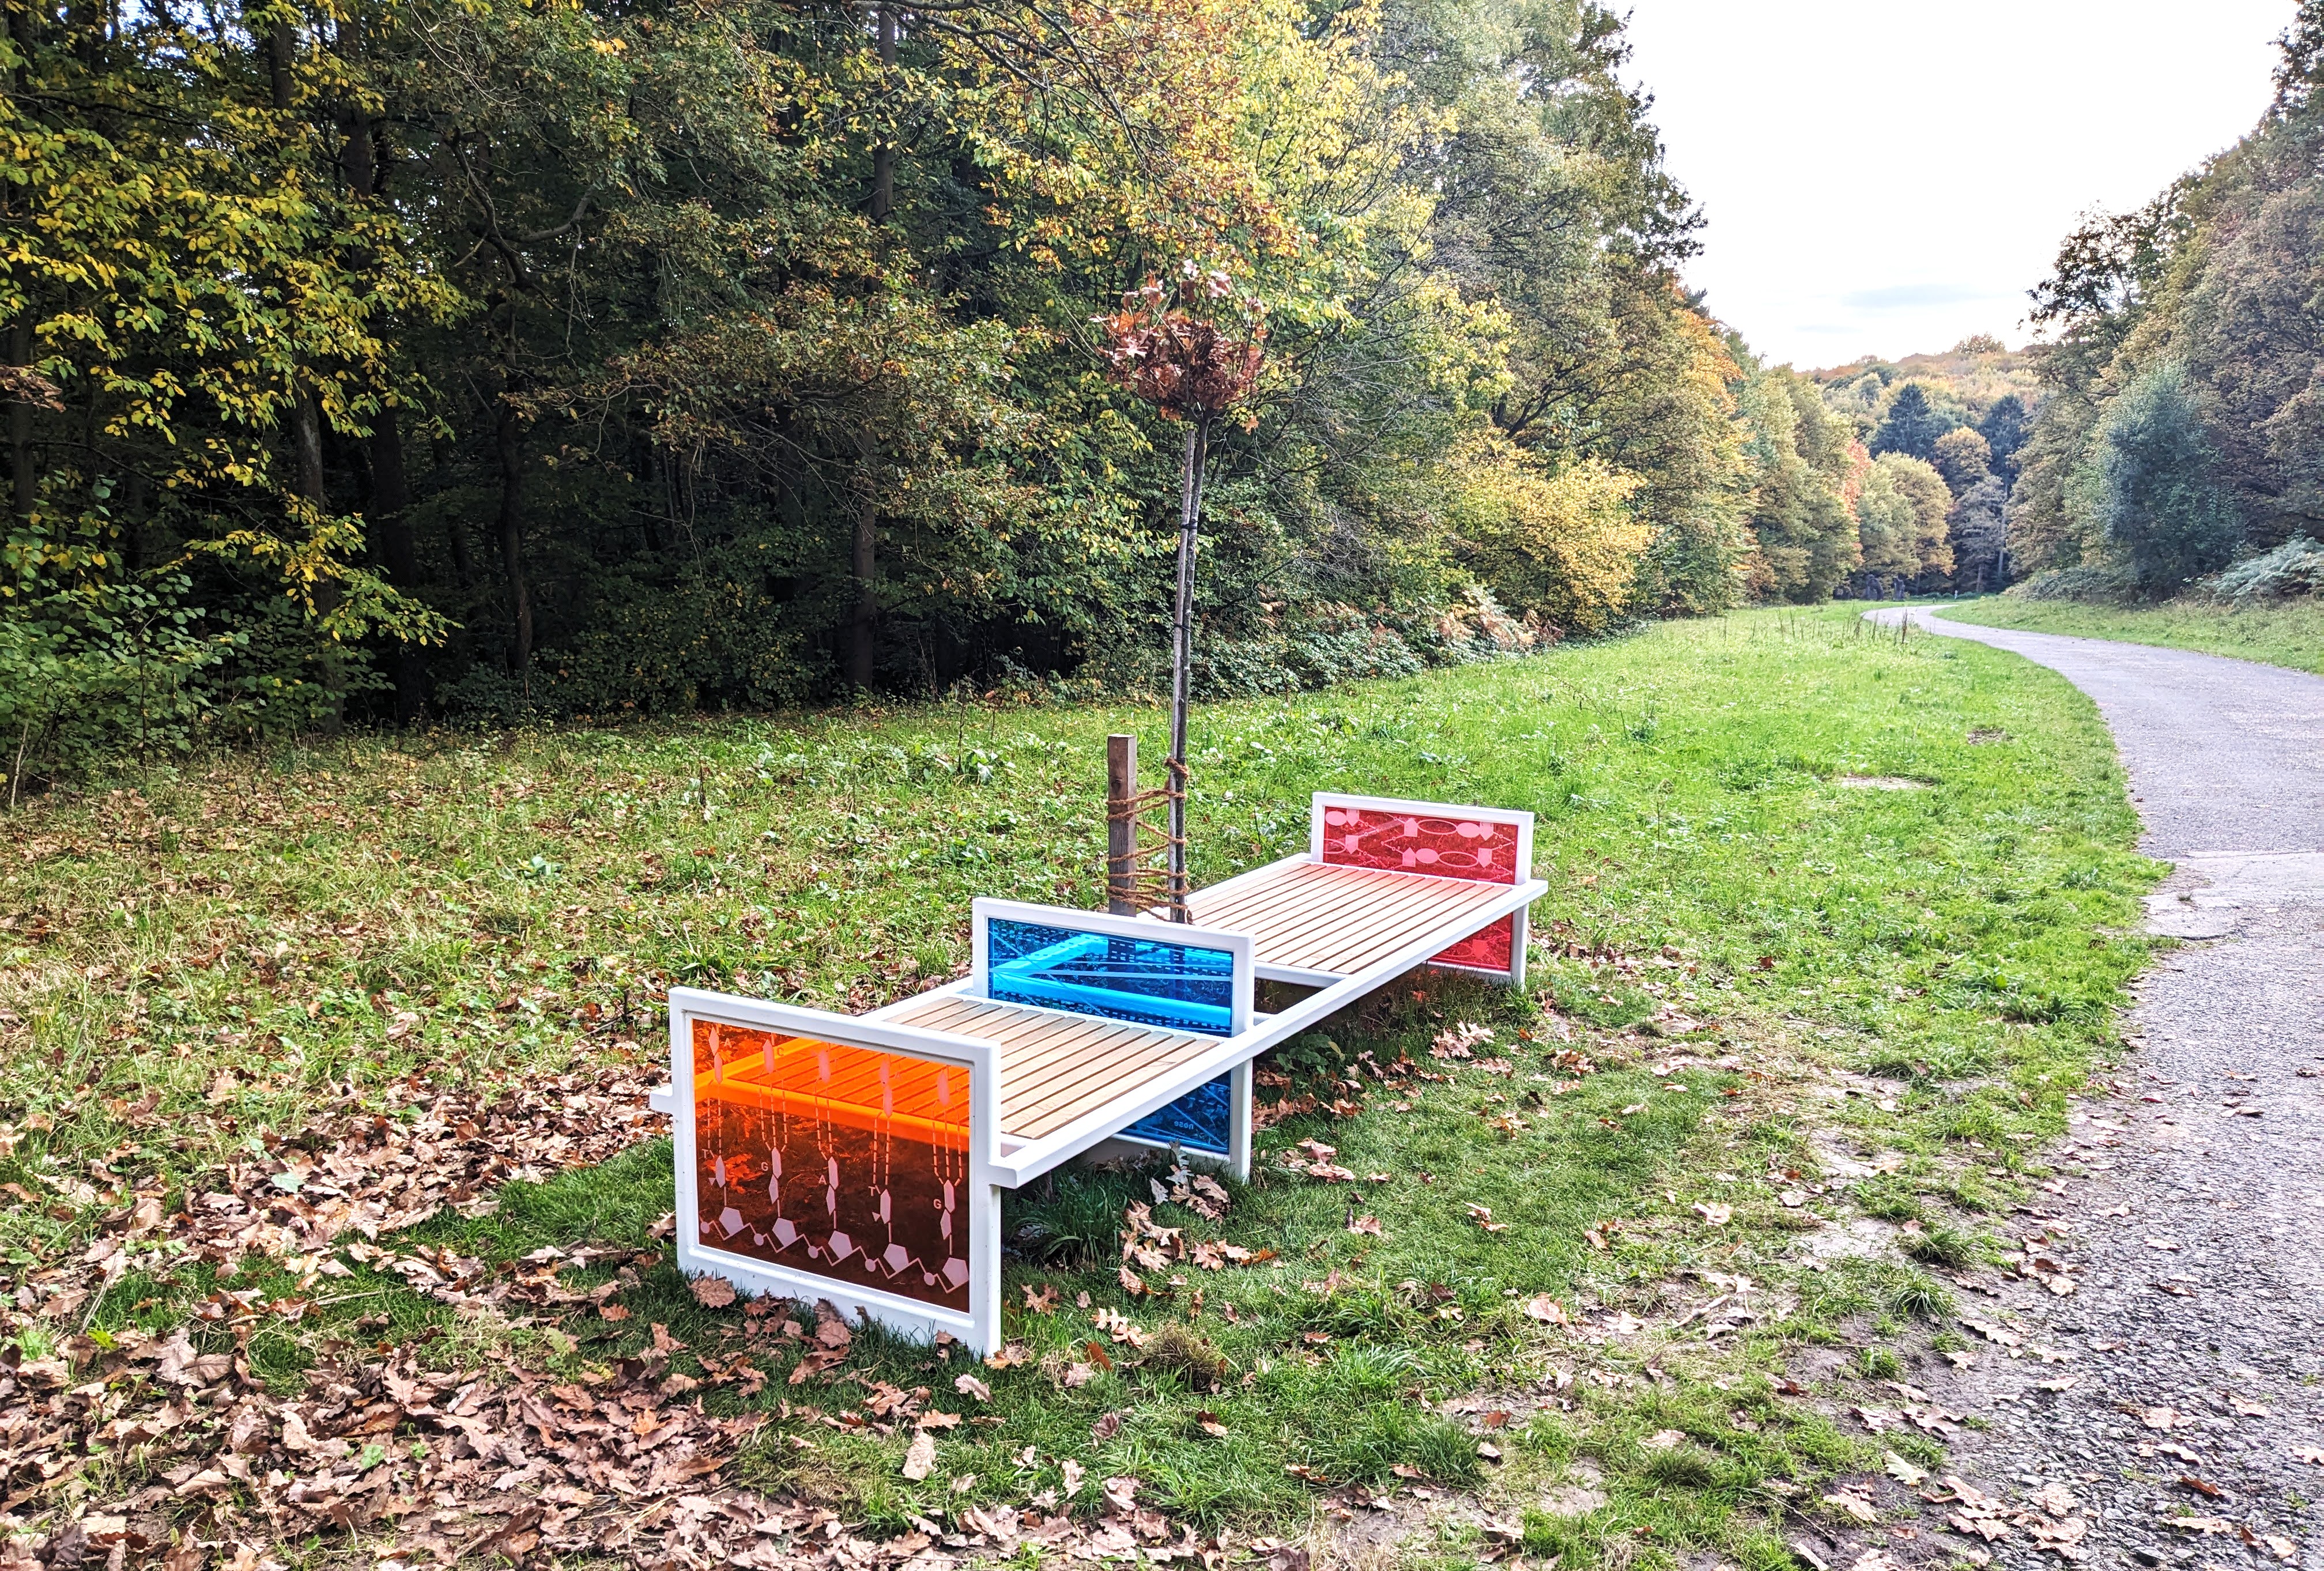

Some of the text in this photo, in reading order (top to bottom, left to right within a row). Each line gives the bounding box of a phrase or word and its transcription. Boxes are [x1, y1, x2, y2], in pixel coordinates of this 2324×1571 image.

[723, 1037, 733, 1048] A
[776, 1047, 784, 1056] C
[701, 1149, 709, 1159] T
[761, 1161, 769, 1172] G
[818, 1175, 828, 1185] A
[868, 1185, 876, 1197] T
[933, 1198, 942, 1210] G
